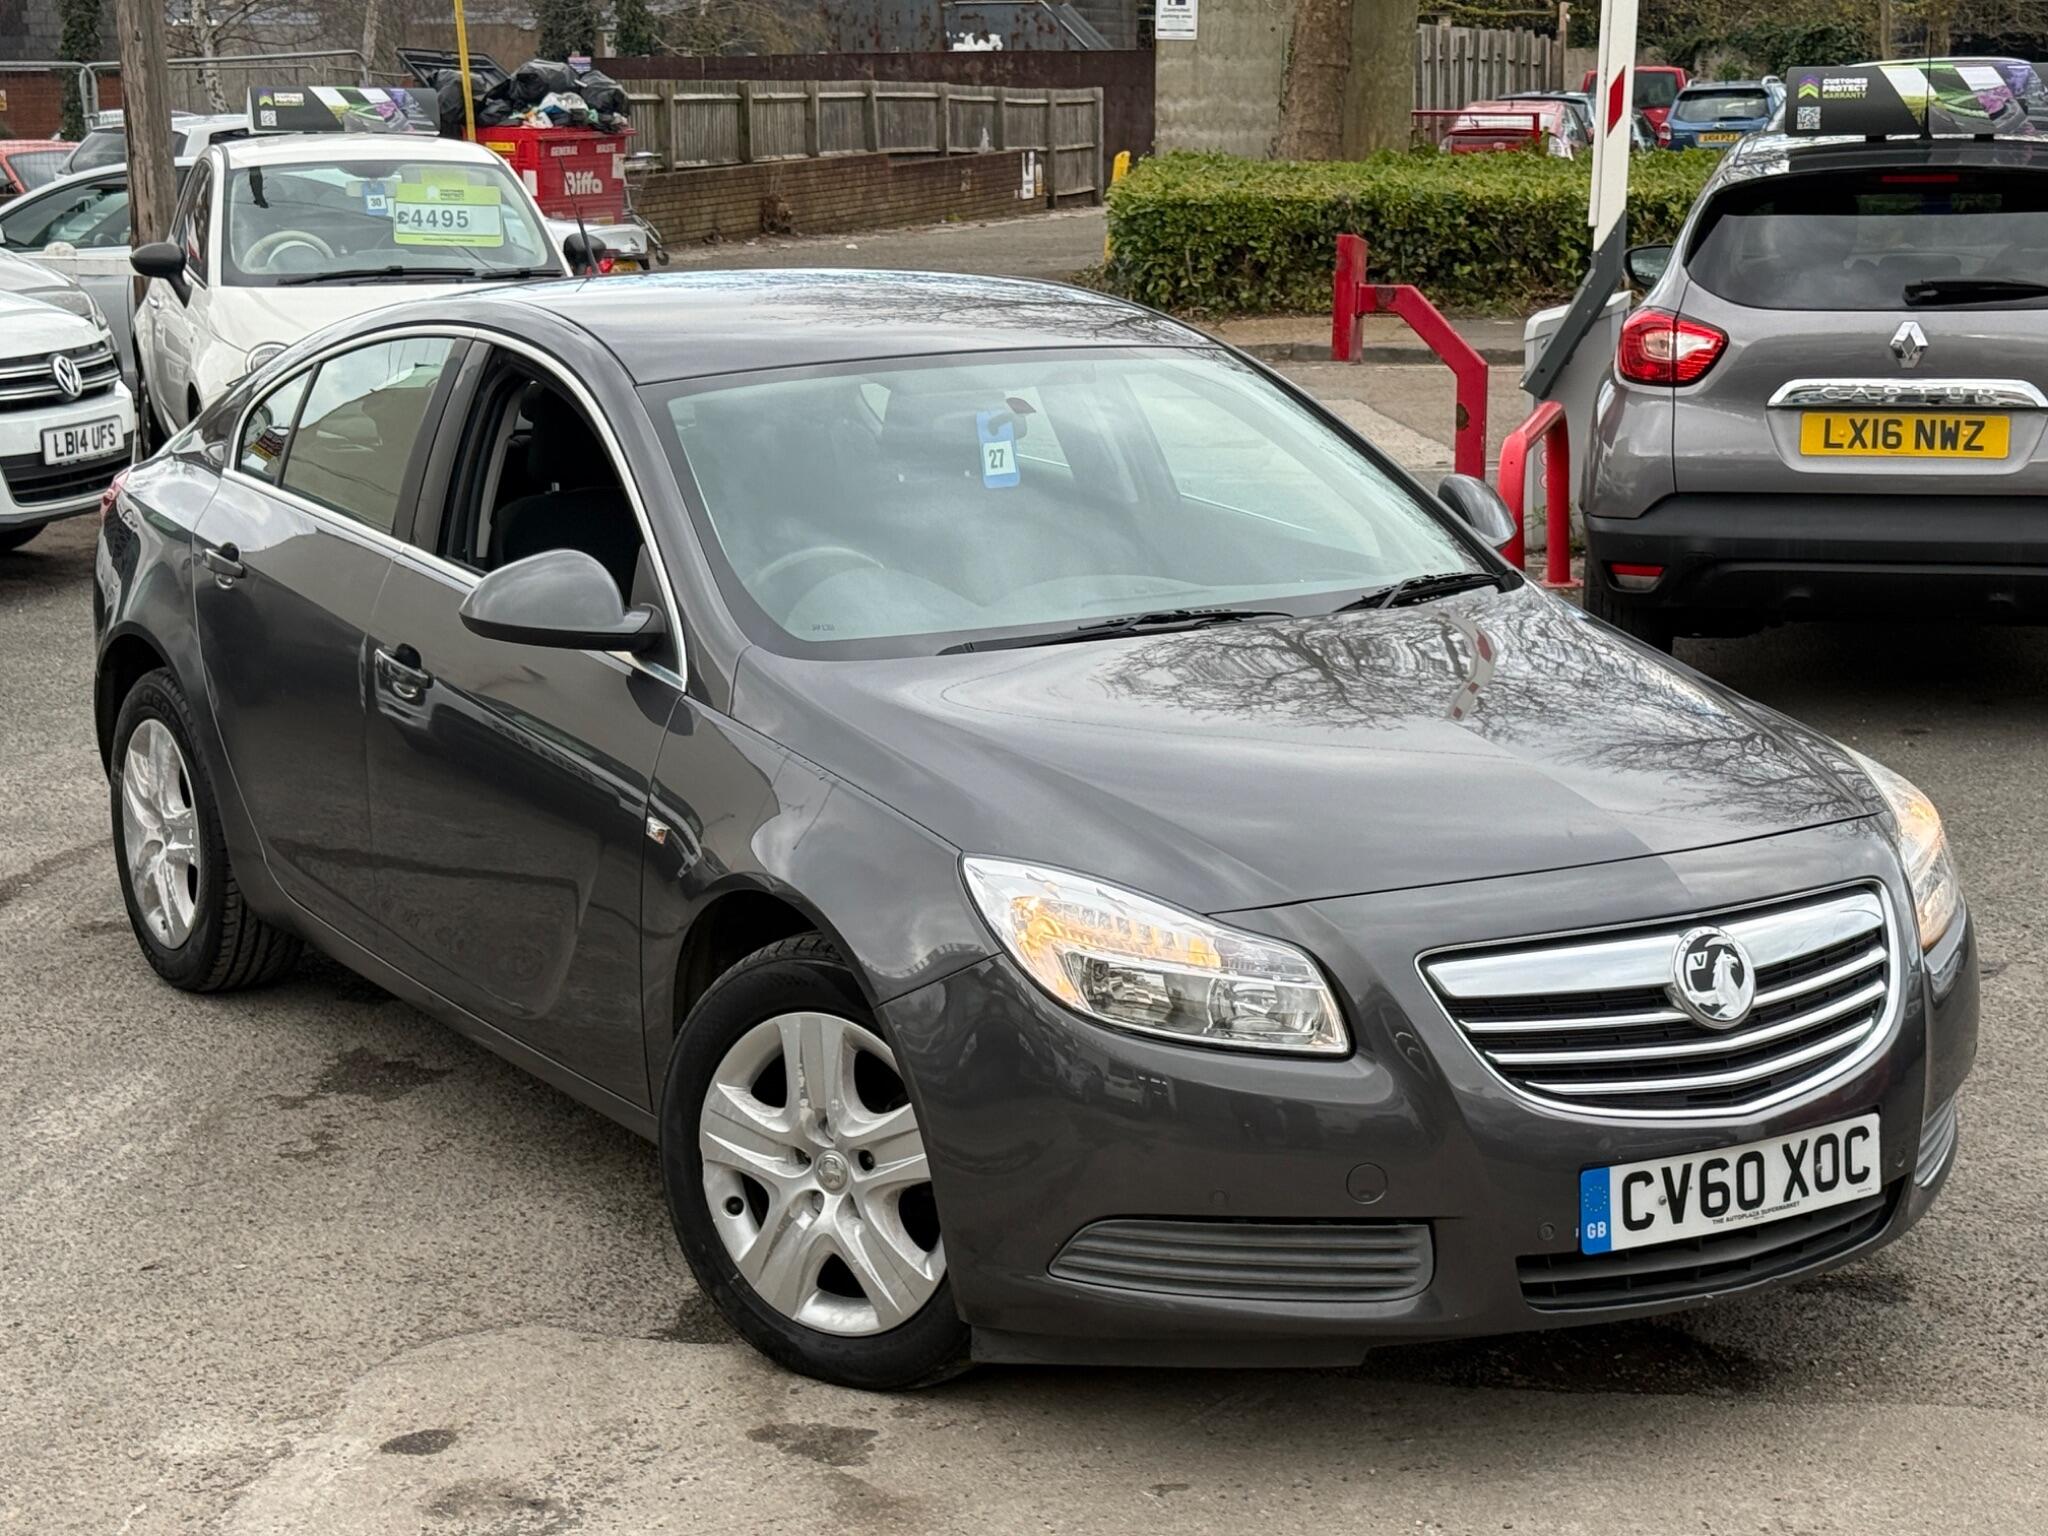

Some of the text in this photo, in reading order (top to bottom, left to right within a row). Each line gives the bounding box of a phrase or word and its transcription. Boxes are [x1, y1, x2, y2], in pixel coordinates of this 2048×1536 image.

[1822, 84, 1868, 92] PROTECT
[551, 145, 578, 157] GENERAL
[564, 171, 603, 196] Biffa
[397, 209, 469, 228] £4495
[1820, 386, 2000, 405] CAPTUR
[53, 423, 116, 457] LB14 UFS
[1823, 418, 1986, 451] LX16 NWZ
[989, 448, 1005, 469] 27
[1622, 1125, 1871, 1231] CV60 XOC
[1712, 1201, 1801, 1225] THE AUTOPLAZA SUPERMARKET
[1586, 1221, 1607, 1239] GB
